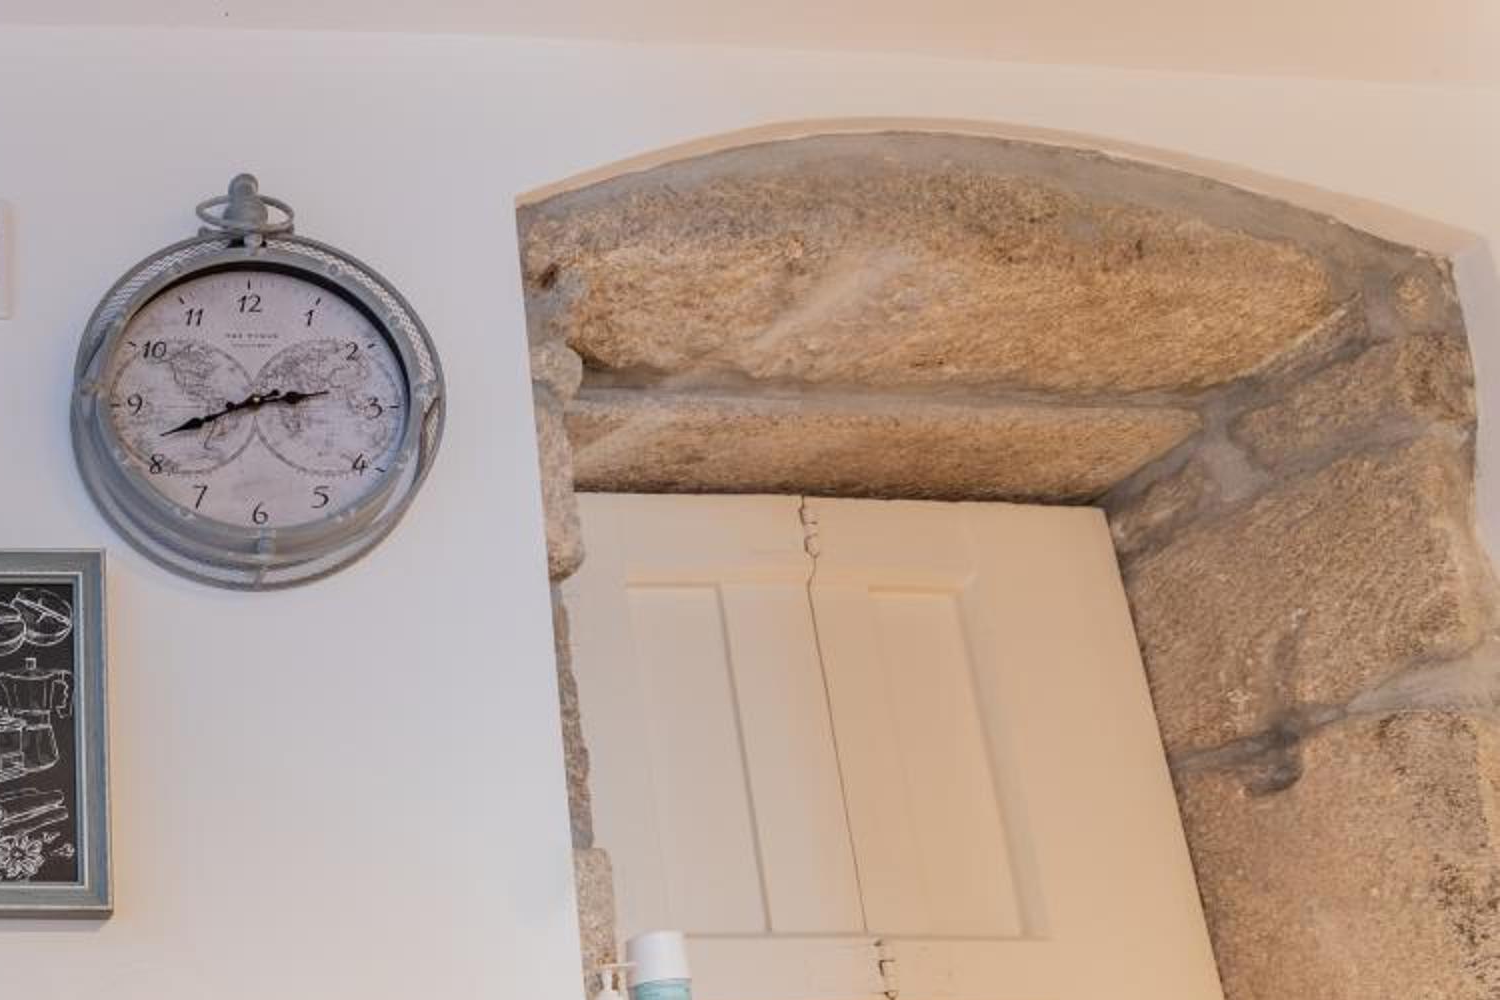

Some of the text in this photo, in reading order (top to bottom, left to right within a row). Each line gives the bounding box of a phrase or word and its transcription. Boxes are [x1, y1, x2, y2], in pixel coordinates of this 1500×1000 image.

[237, 294, 262, 313] 12
[185, 309, 204, 327] 11
[305, 310, 315, 326] 1
[141, 341, 168, 359] 10
[345, 342, 359, 360] 2
[127, 394, 143, 415] 9
[367, 398, 383, 418] 3
[149, 454, 165, 475] 8
[352, 454, 369, 476] 4
[193, 485, 209, 509] 7
[311, 486, 330, 509] 5
[252, 502, 269, 525] 6
